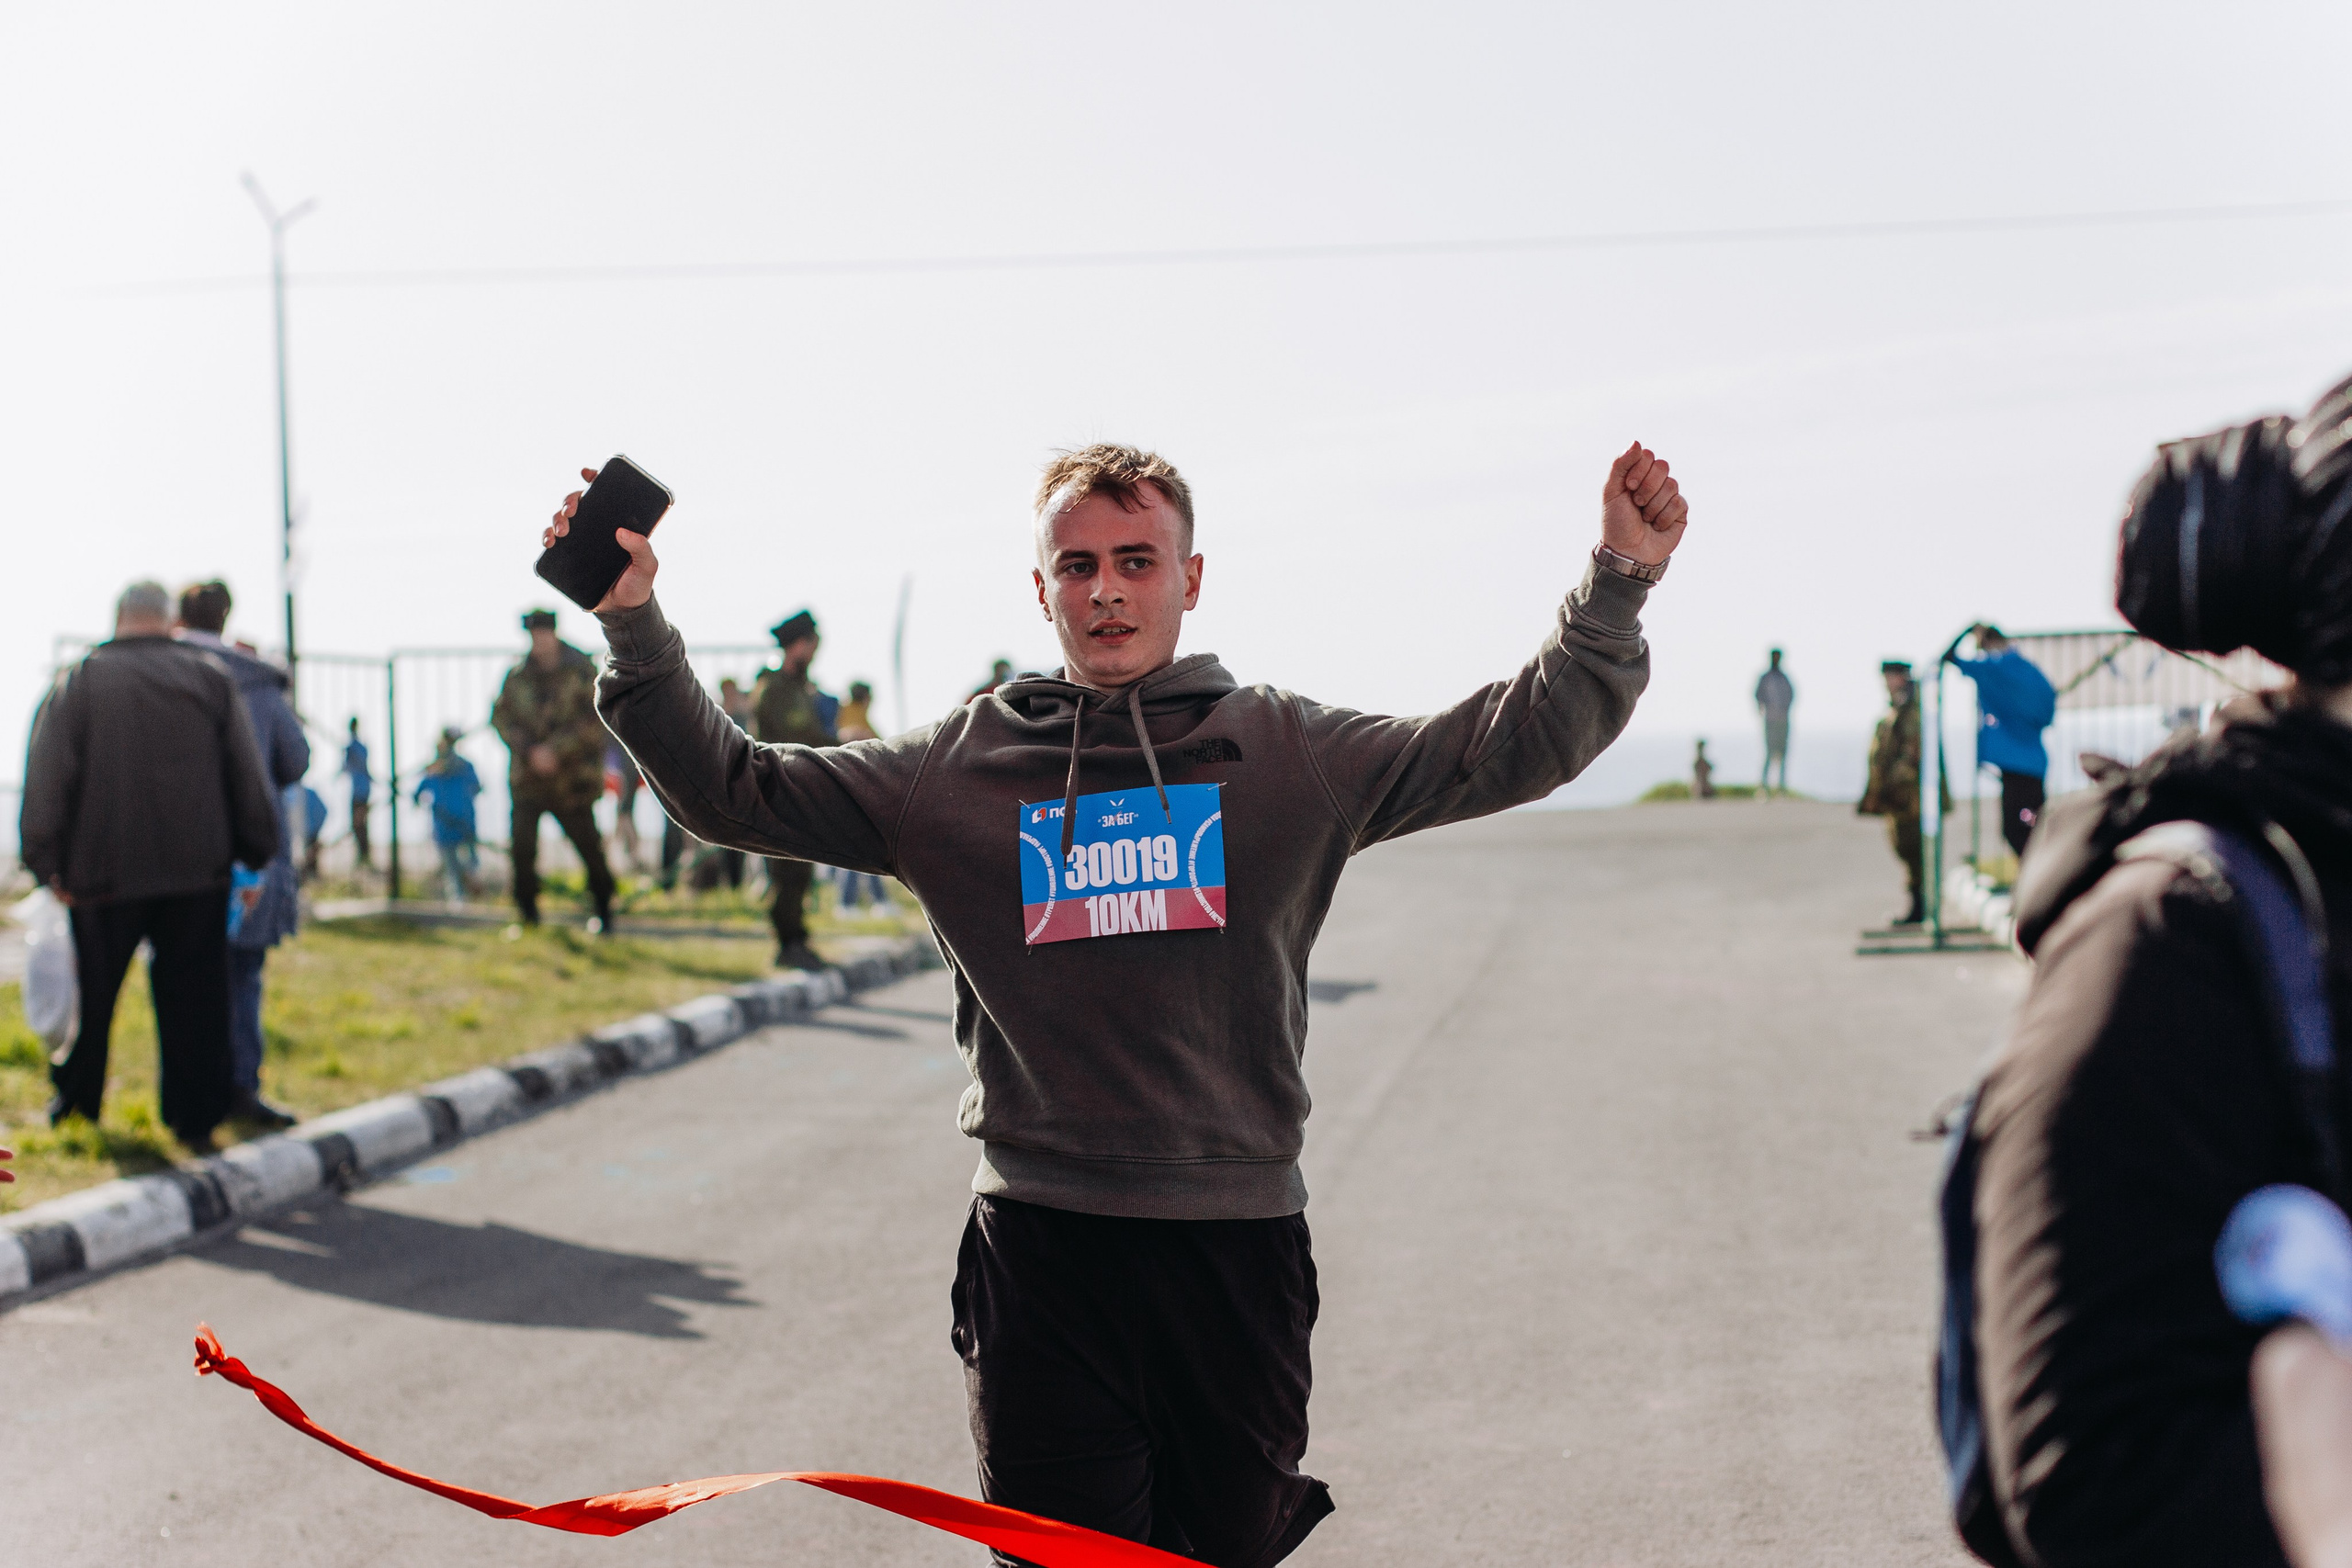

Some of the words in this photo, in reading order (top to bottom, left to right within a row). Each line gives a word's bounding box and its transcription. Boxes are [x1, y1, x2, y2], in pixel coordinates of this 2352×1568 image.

[1198, 738, 1220, 747] THE
[1183, 747, 1222, 758] NORTH
[1195, 754, 1222, 764] FACE
[1065, 834, 1179, 890] 30019
[1084, 888, 1168, 938] 10КМ
